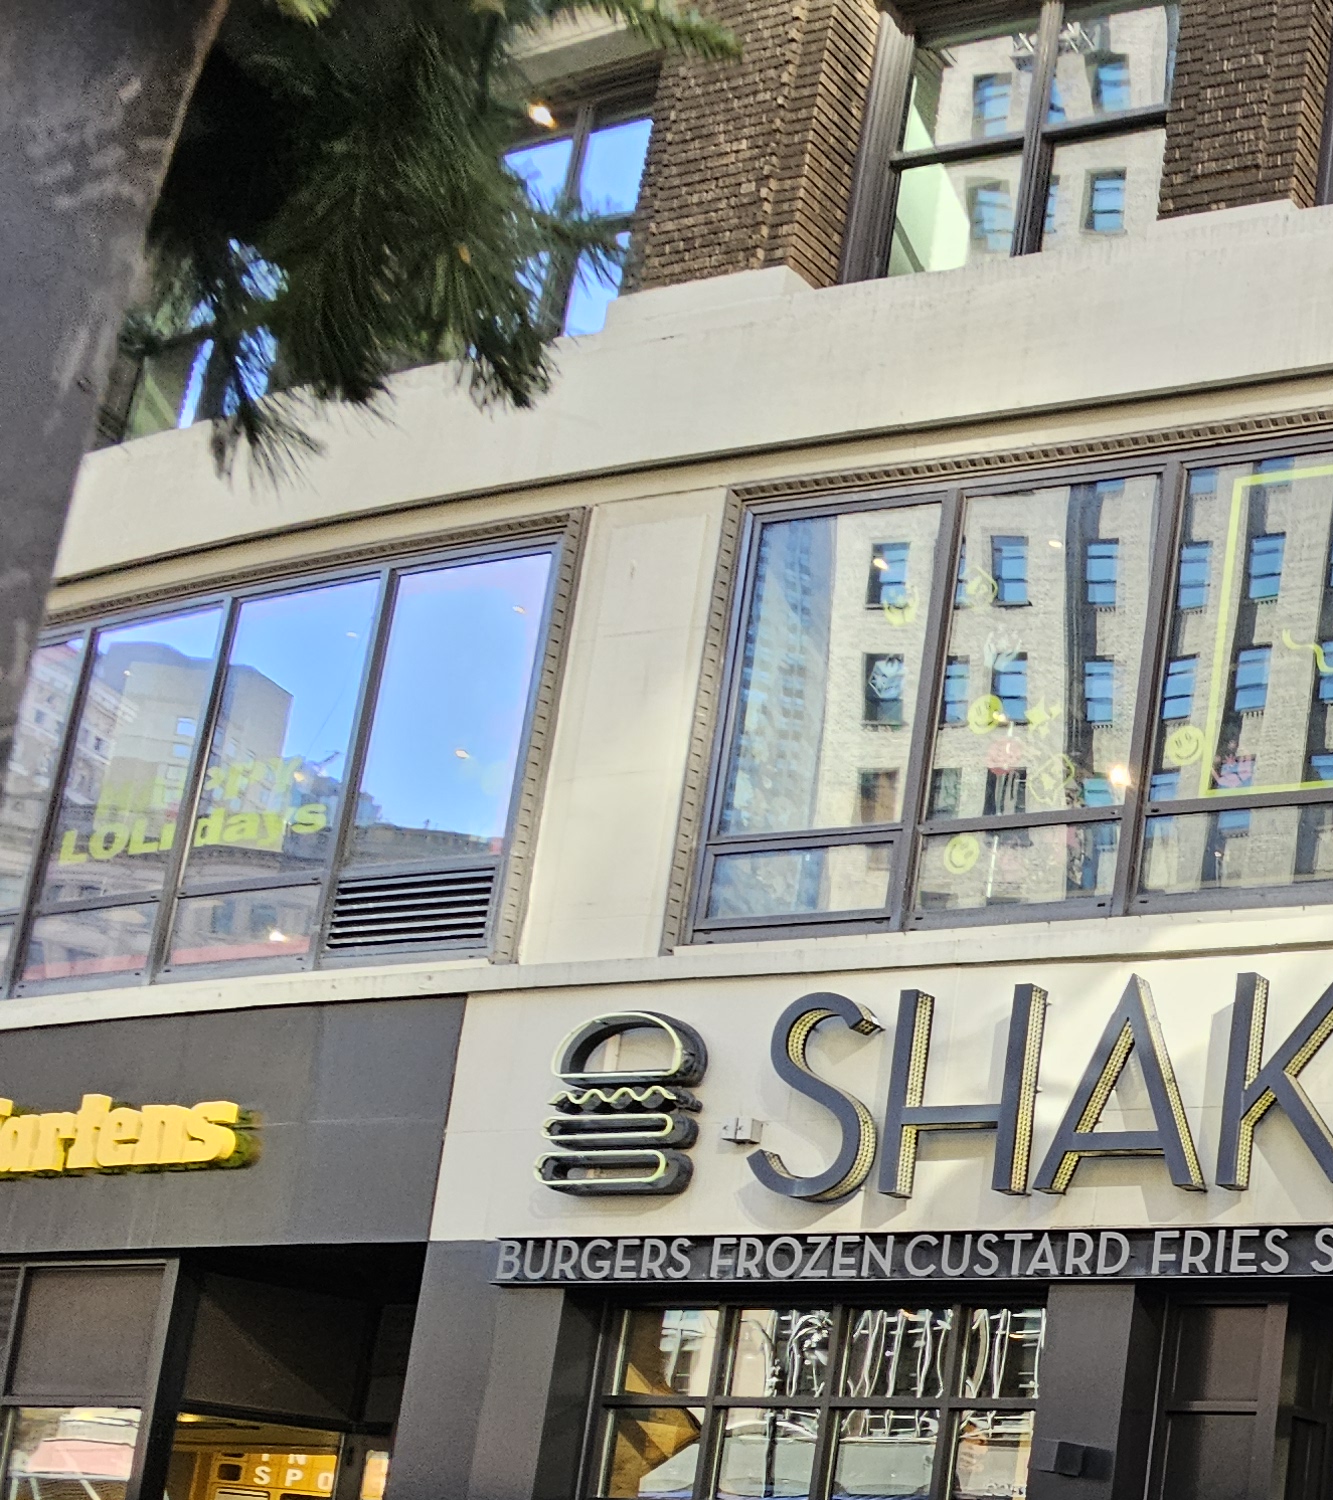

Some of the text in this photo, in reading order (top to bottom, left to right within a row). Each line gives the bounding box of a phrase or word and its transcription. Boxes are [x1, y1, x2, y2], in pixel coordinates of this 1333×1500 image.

[0, 1094, 241, 1173] artens
[497, 1239, 691, 1281] BURGERS
[709, 1235, 895, 1279] FROZEN
[903, 1232, 1131, 1277] CUSTARD
[1150, 1228, 1290, 1275] FRIES
